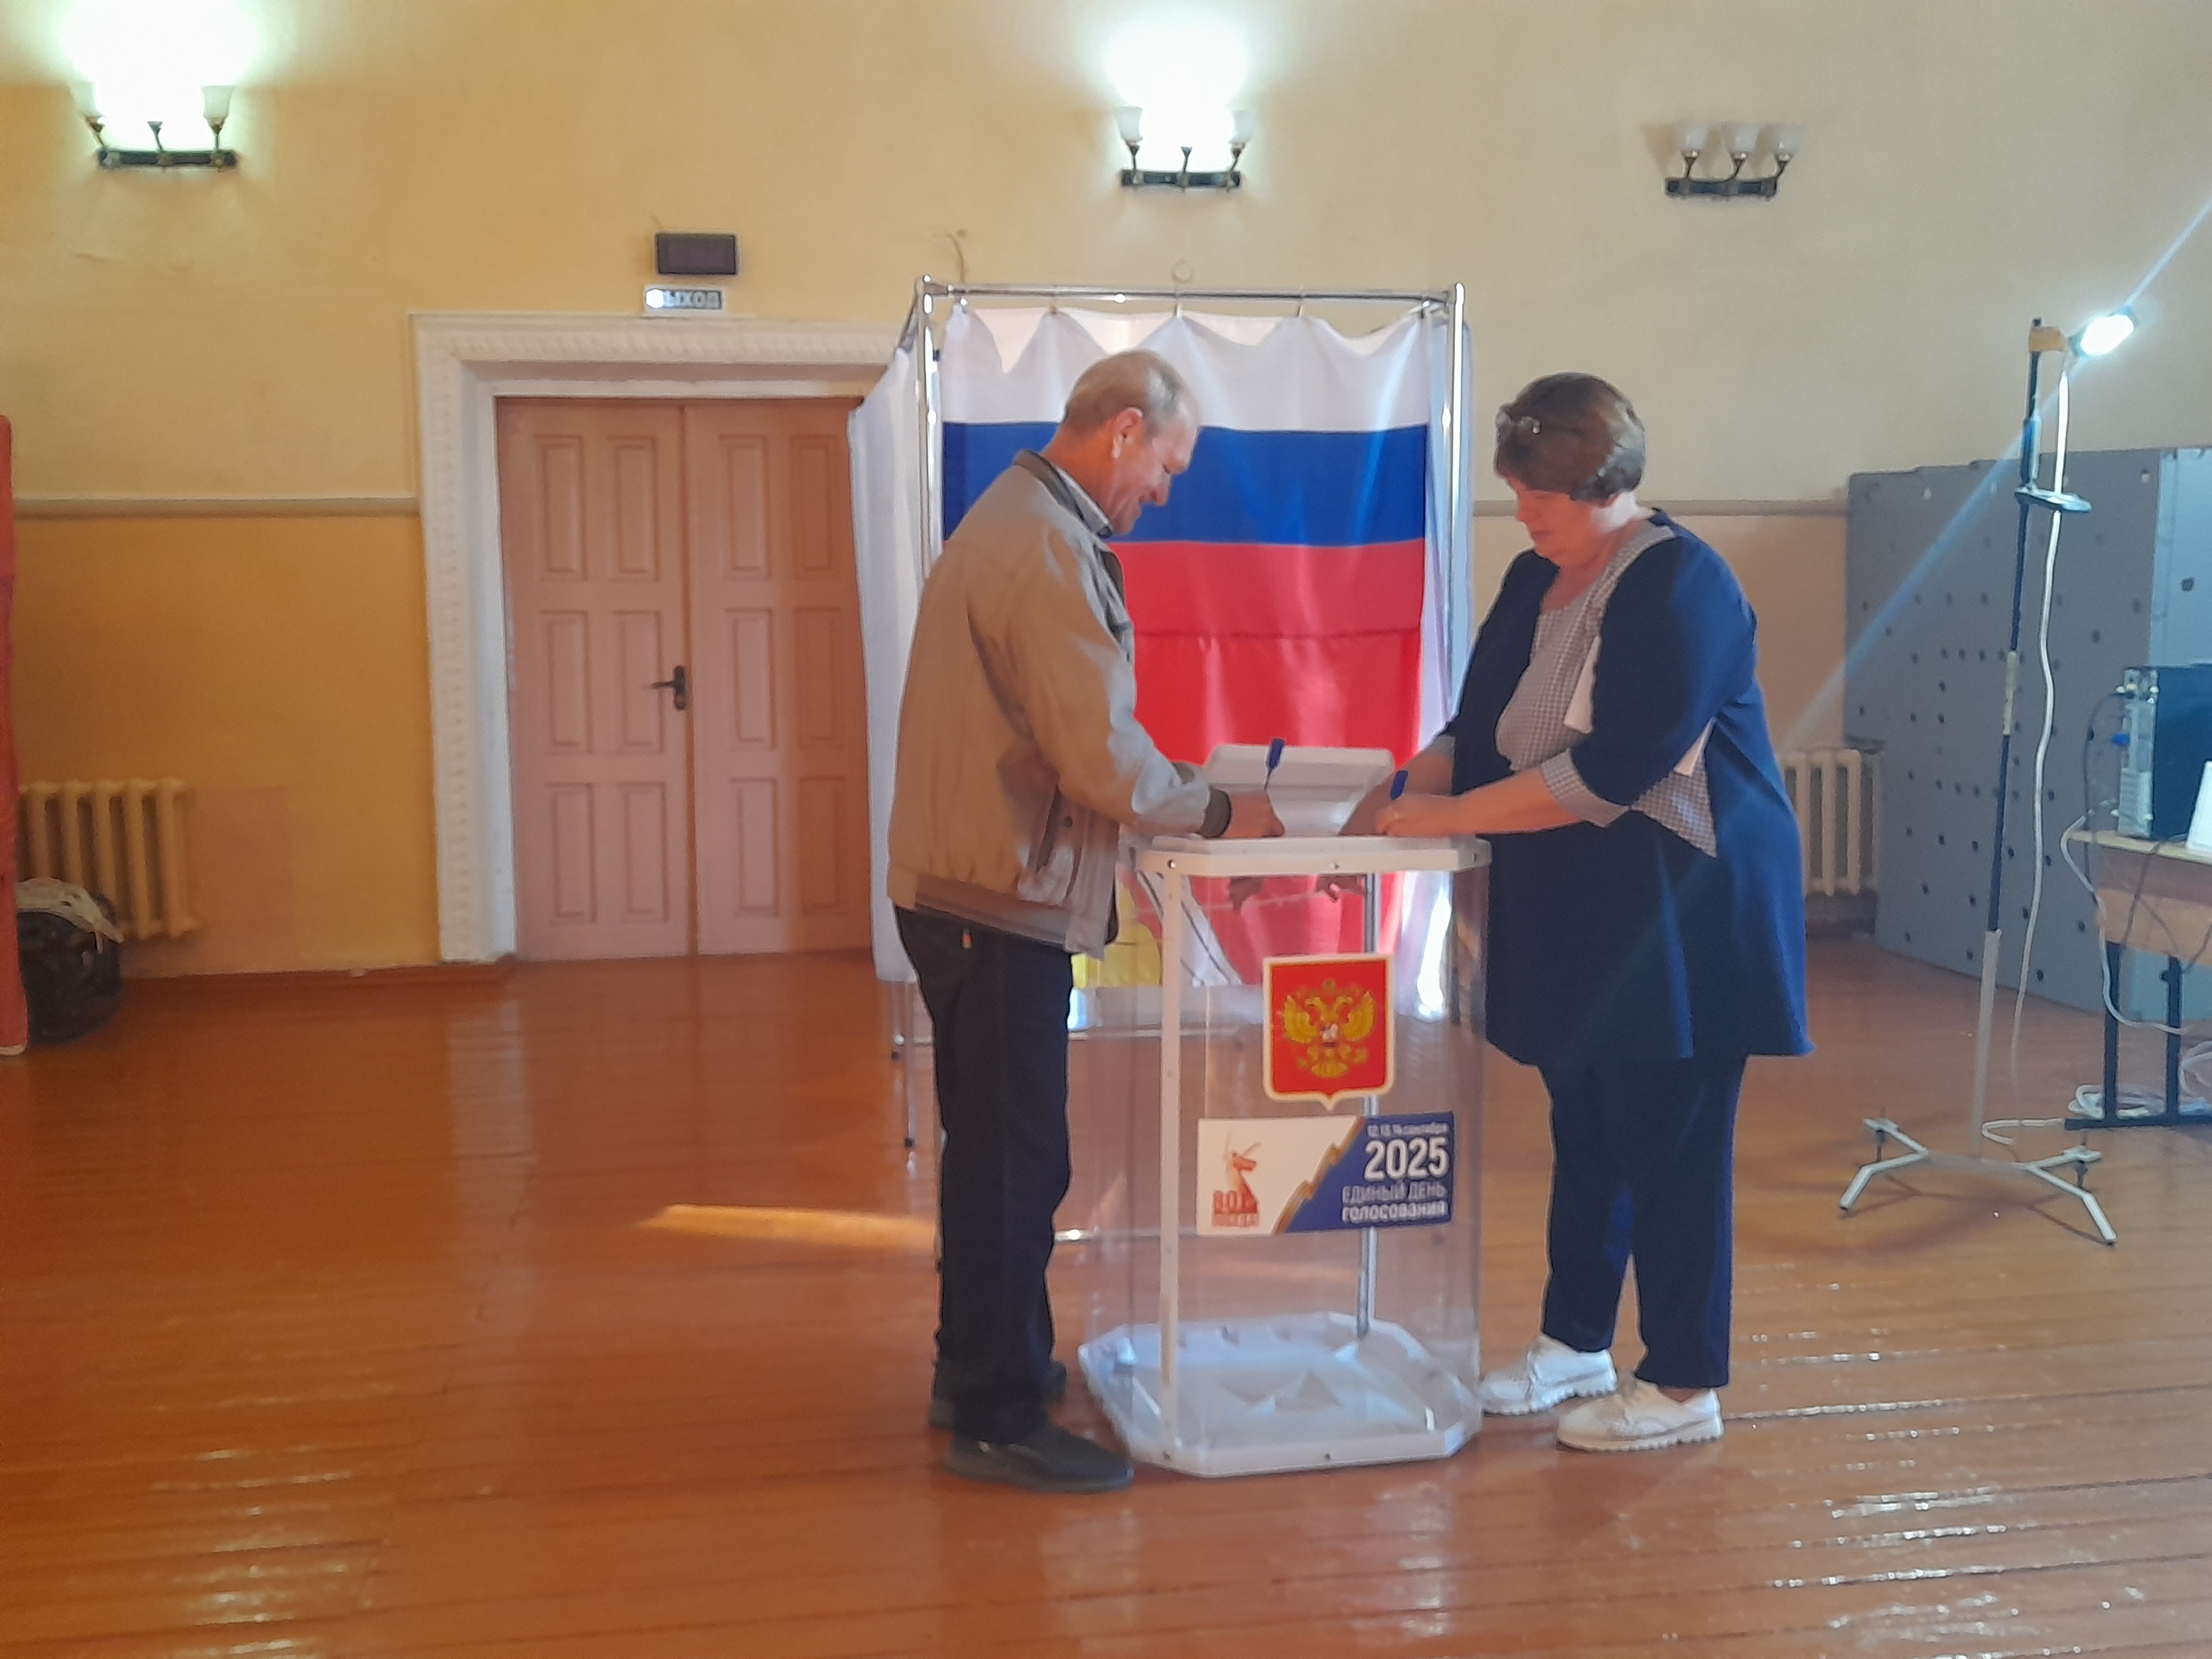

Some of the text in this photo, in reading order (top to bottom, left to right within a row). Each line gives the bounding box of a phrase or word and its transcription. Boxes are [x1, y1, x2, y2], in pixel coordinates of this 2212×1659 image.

[1364, 1136, 1449, 1180] 2025
[1342, 1180, 1447, 1204] ЕДИНЫЙ ДЕНЬ
